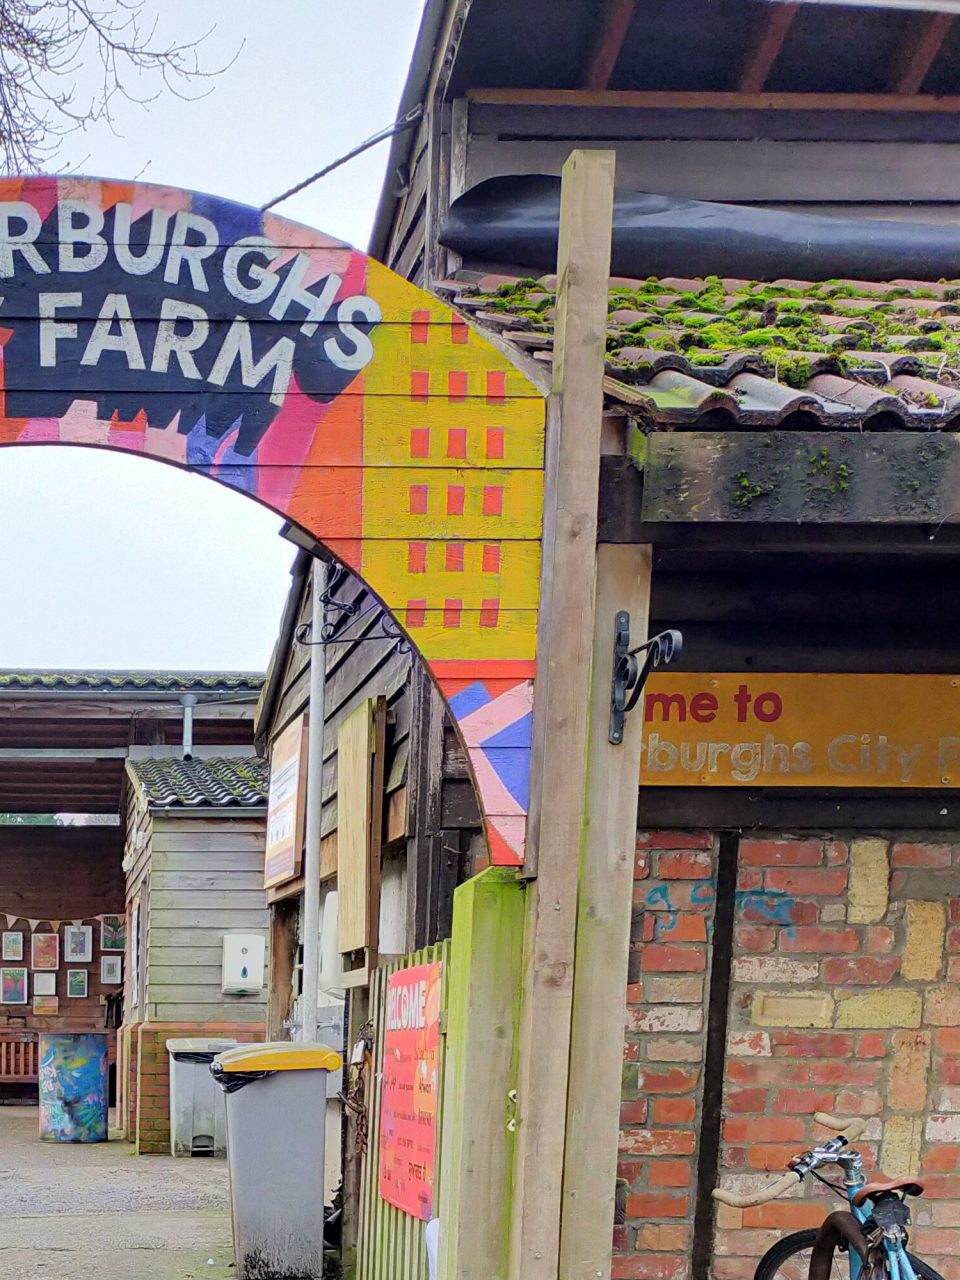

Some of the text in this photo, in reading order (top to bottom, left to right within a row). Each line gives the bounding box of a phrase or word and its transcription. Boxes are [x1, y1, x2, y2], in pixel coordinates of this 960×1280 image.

[38, 292, 296, 407] FARM
[733, 684, 783, 723] to
[641, 731, 812, 782] burghs
[826, 733, 922, 783] City
[385, 980, 427, 1032] WELCOME
